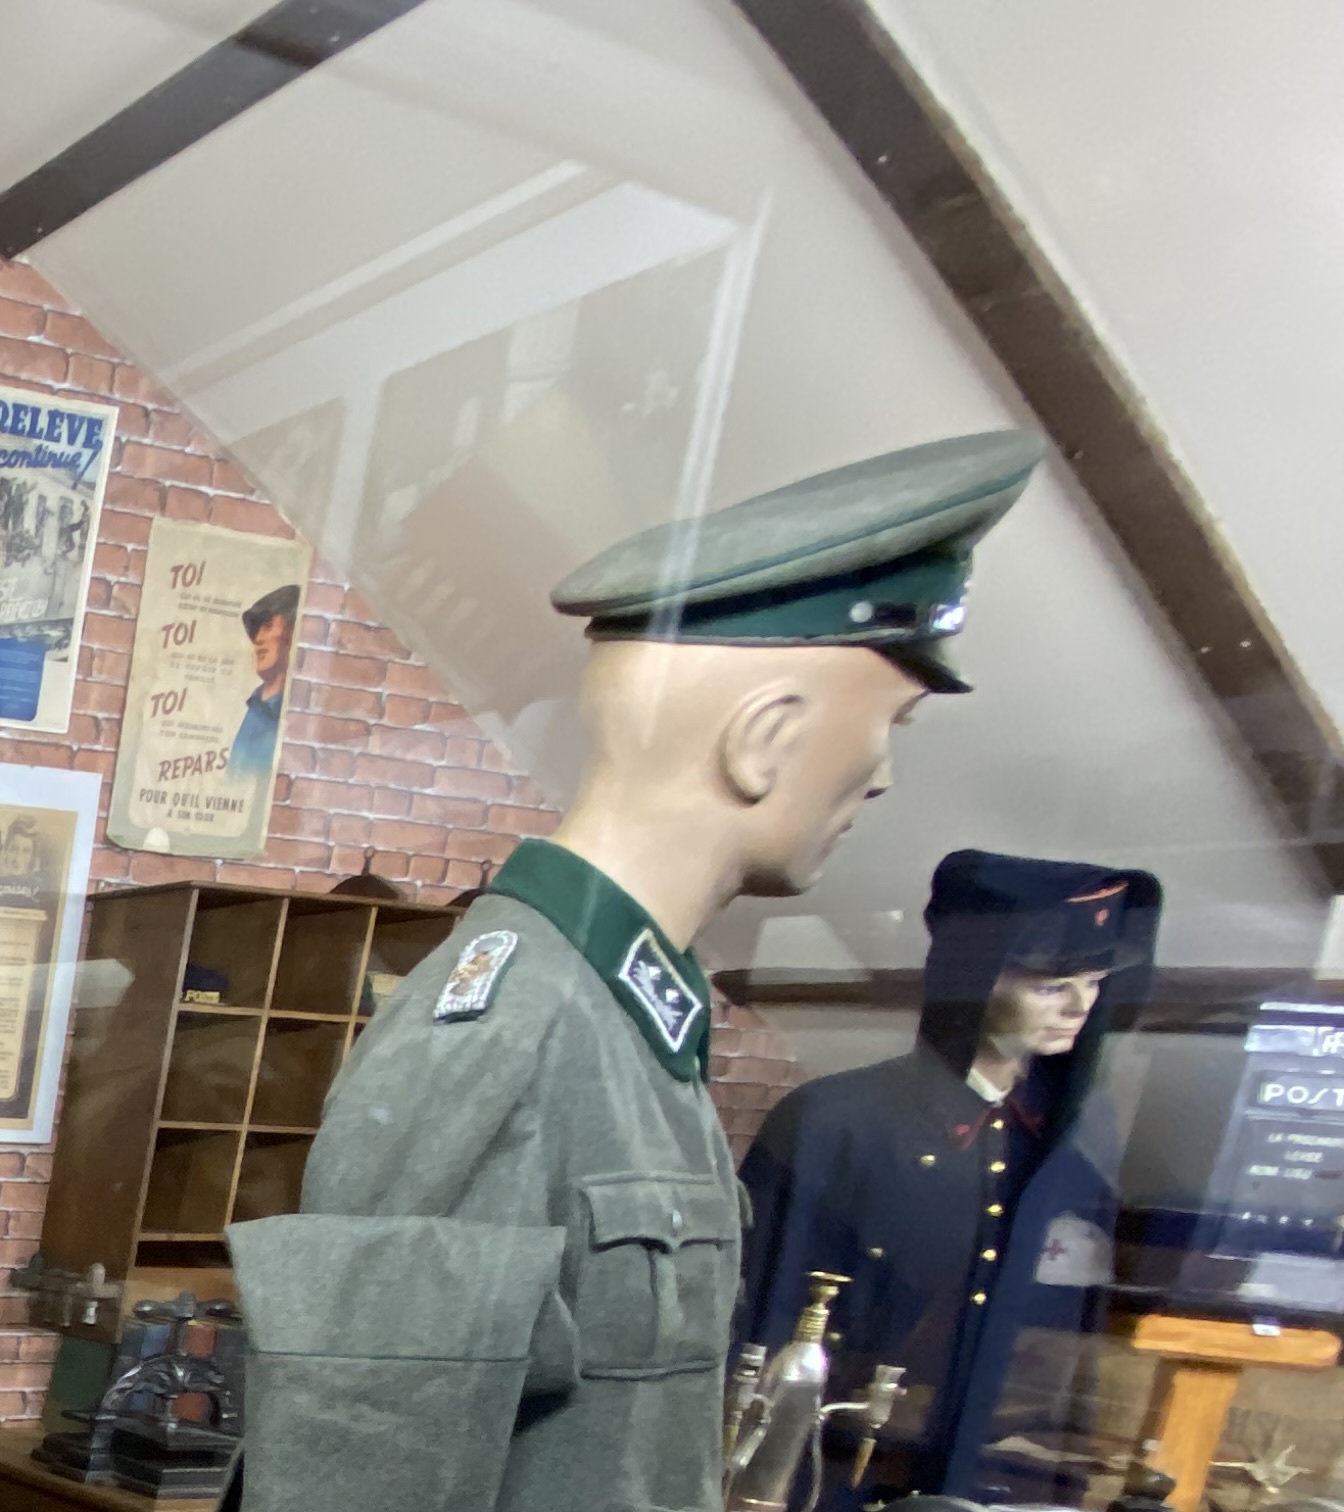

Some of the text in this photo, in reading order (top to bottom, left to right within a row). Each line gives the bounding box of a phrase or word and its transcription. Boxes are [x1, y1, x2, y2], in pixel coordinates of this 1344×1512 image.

[170, 561, 207, 590] TOI
[161, 619, 197, 649] TOI
[151, 688, 188, 718] TOI
[158, 747, 229, 782] REPARS
